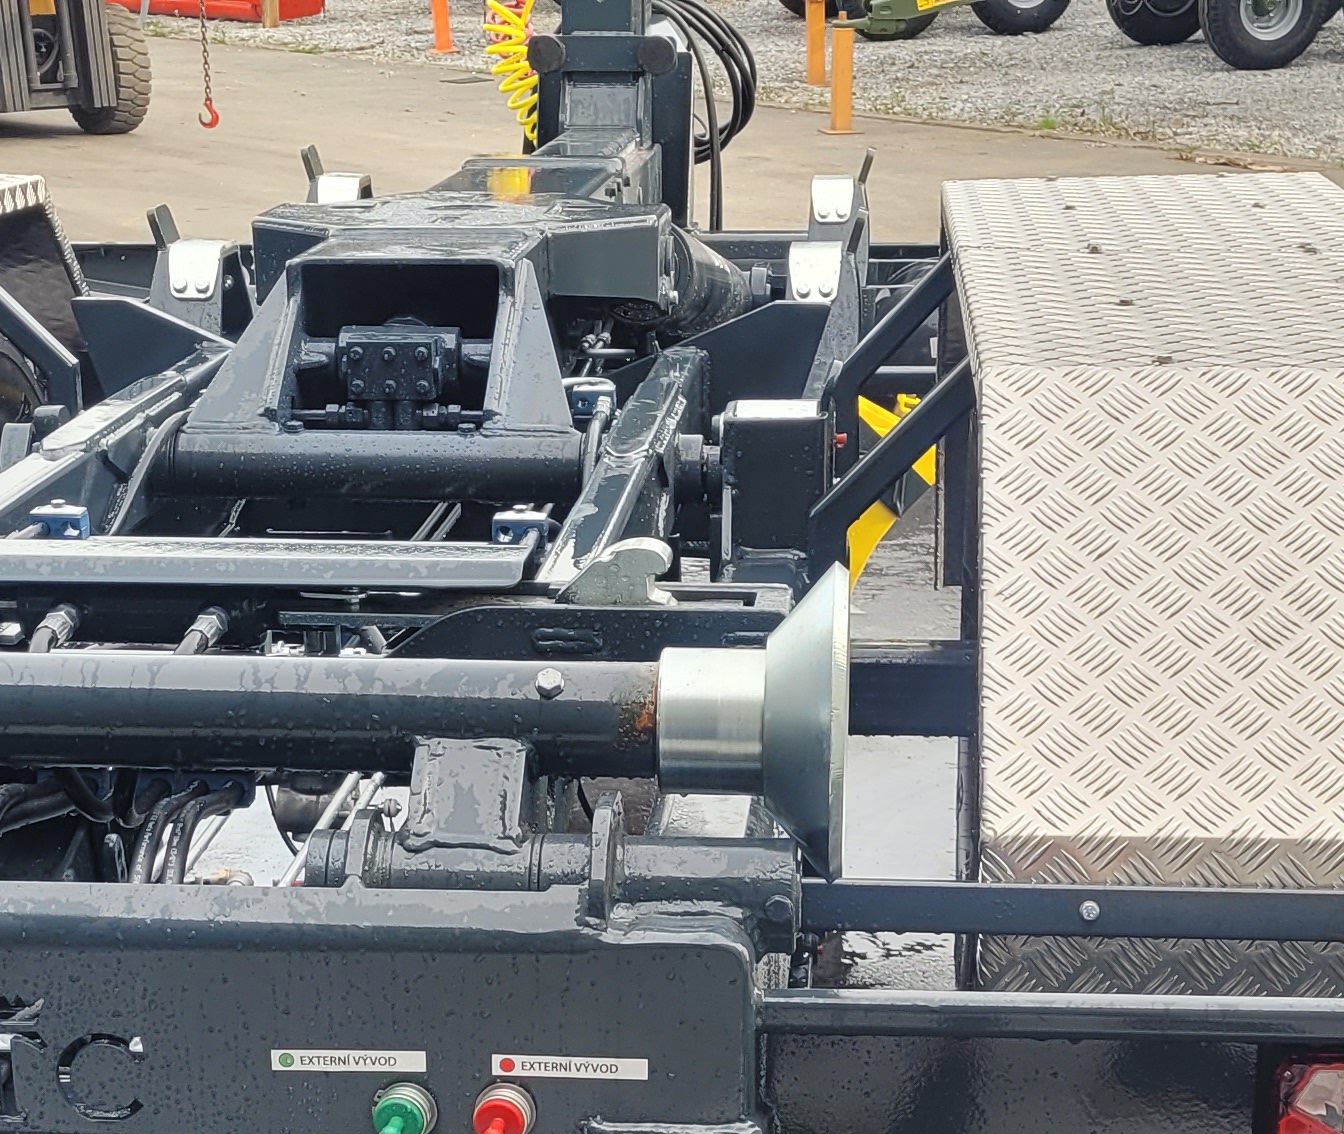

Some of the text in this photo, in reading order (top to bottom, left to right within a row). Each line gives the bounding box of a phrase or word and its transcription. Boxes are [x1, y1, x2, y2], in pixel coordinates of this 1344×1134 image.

[299, 1053, 398, 1067] EXTERNÍ VÝVOD
[520, 1060, 619, 1074] EXTERNÍ VÝVOD
